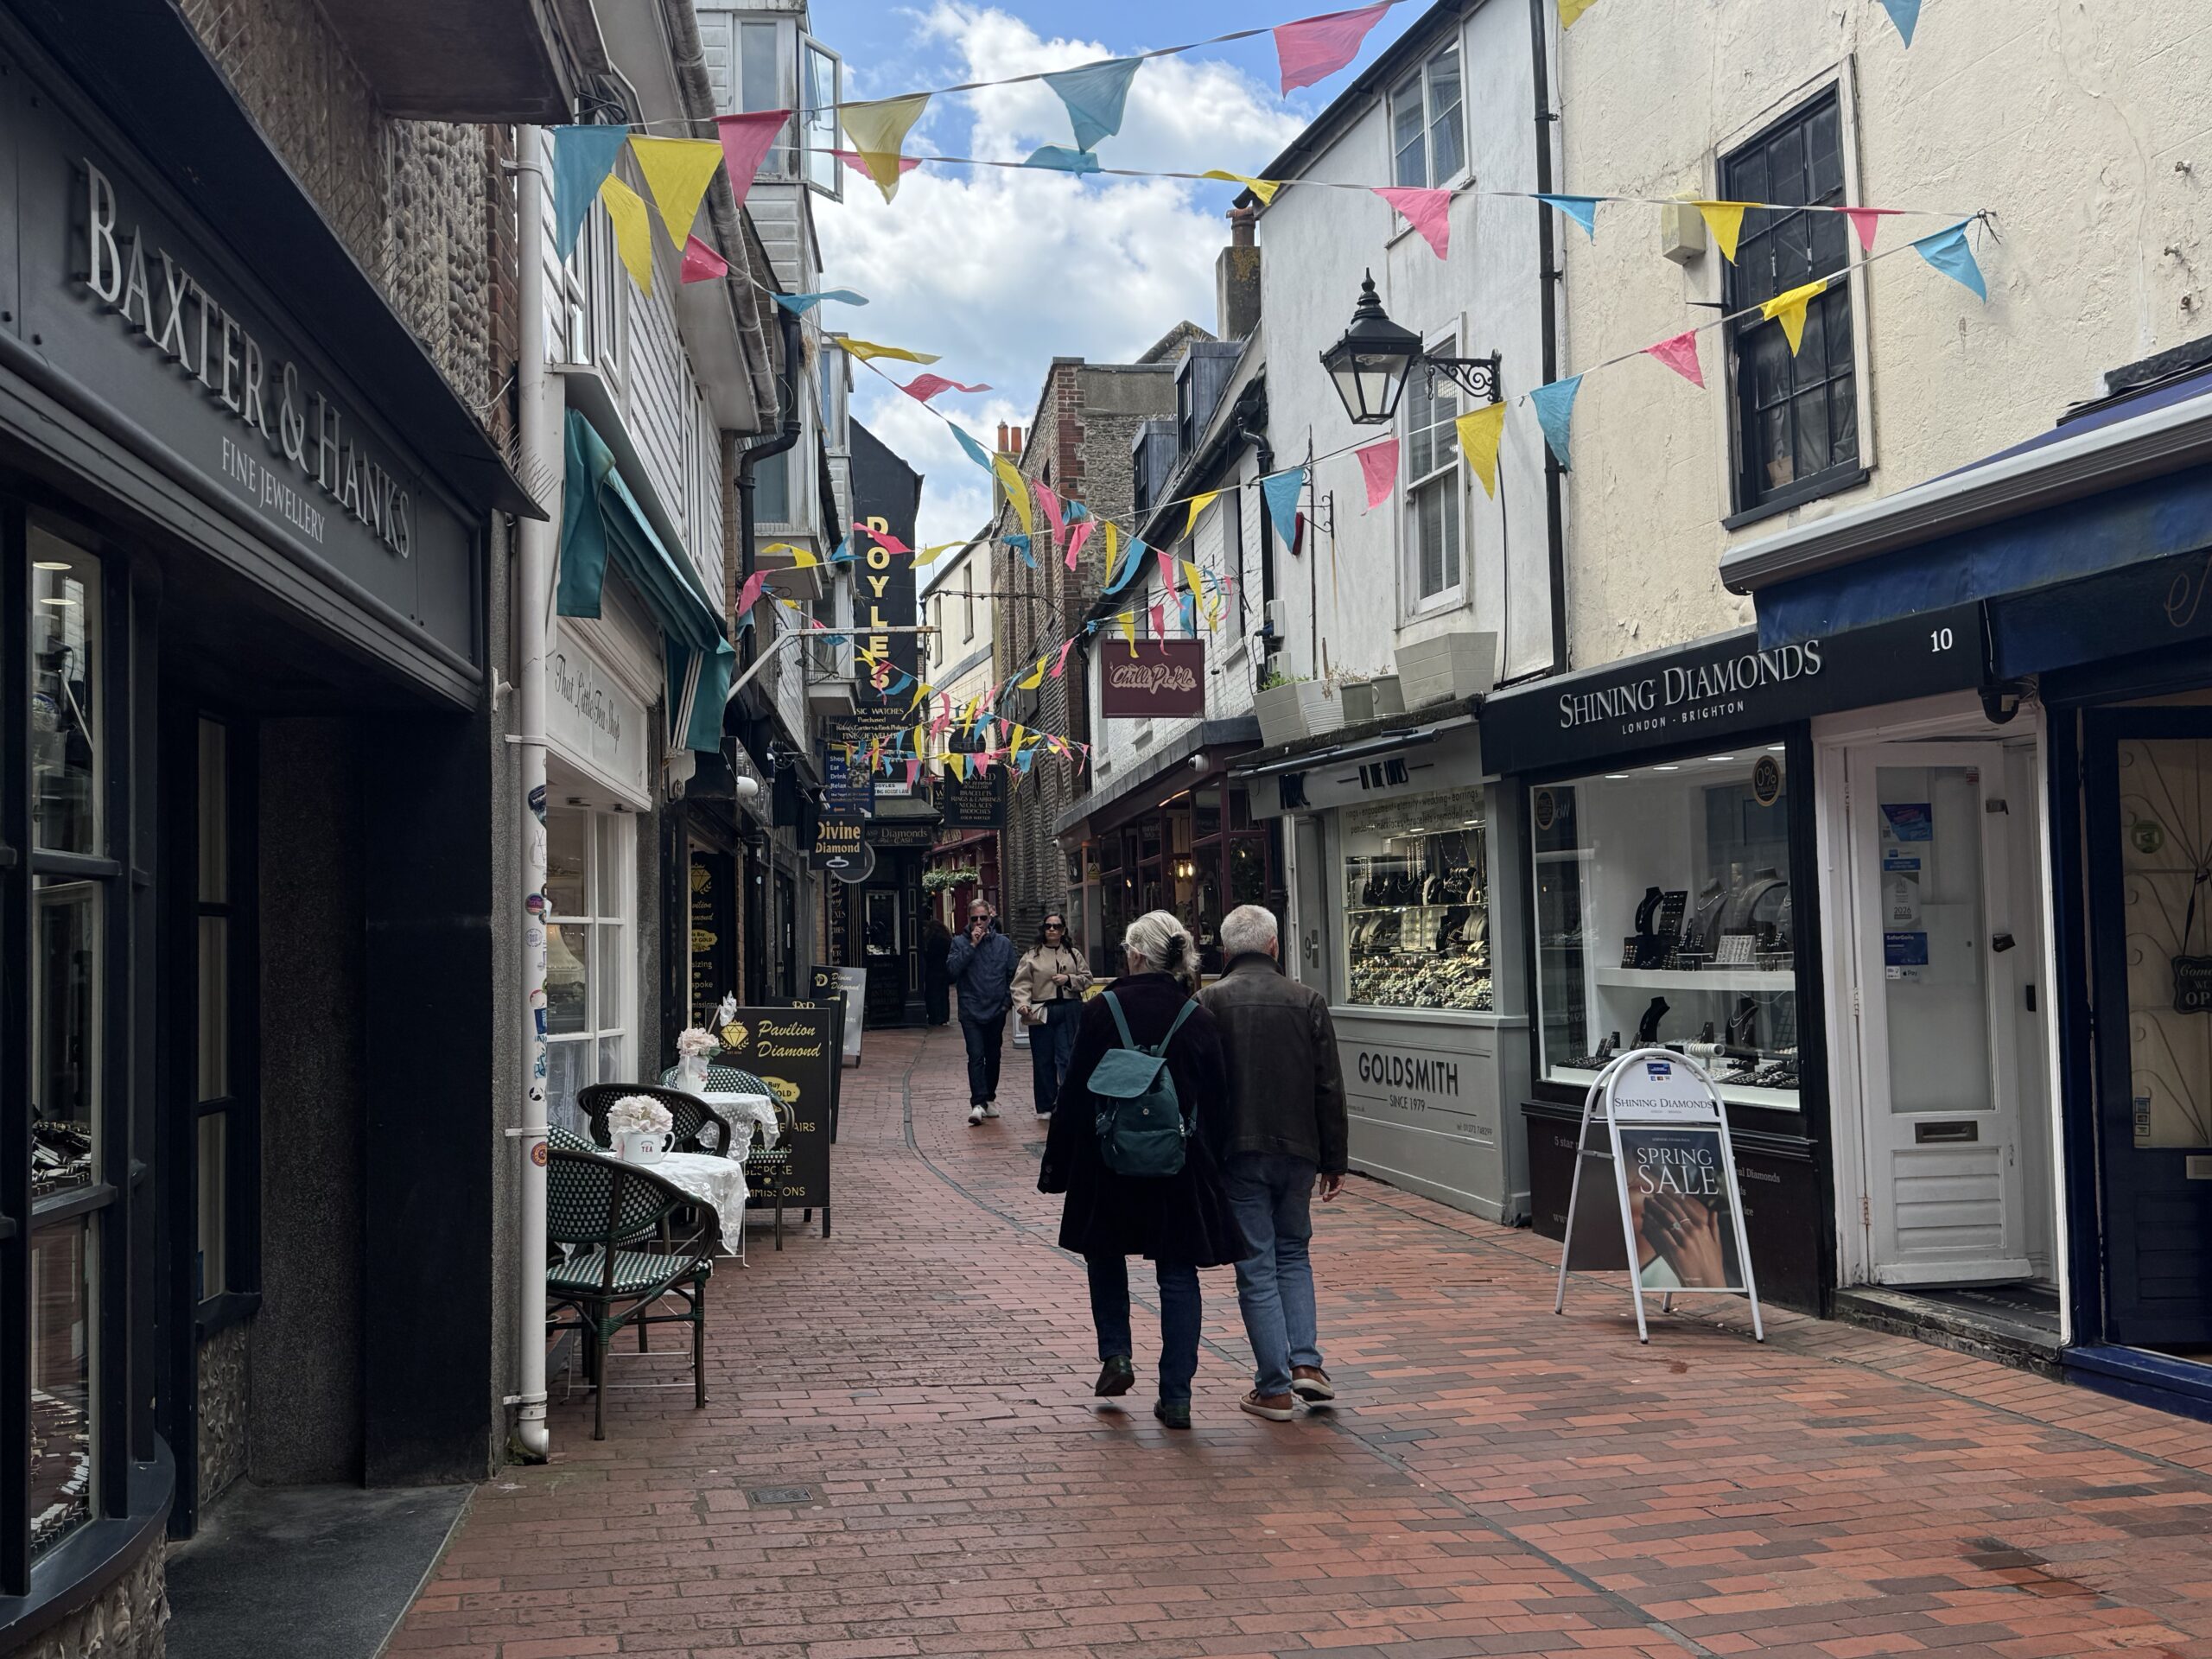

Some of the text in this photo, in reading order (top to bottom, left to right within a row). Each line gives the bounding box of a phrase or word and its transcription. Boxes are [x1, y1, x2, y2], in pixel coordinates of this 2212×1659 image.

[84, 157, 410, 559] BAXTER & HANKS
[221, 436, 324, 543] FINE JEWELLERY
[867, 517, 891, 689] DOYLES
[1930, 628, 1954, 652] 10
[555, 653, 574, 703] That
[575, 671, 594, 719] Little
[594, 690, 605, 729] Tea
[1559, 639, 1823, 728] SHINING DIAMONDS
[1622, 716, 1666, 734] LONDON
[1681, 701, 1745, 724] BRIGHTON
[881, 828, 927, 838] Diamonds
[815, 842, 861, 853] Diamond
[1305, 936, 1312, 960] 9
[2185, 991, 2210, 1005] OP
[758, 1020, 816, 1037] Pavilion
[757, 1040, 822, 1057] Diamond
[1358, 1052, 1459, 1096] GOLDSMITH
[1389, 1095, 1425, 1111] SINCE 1979
[1614, 1097, 1713, 1109] SHINING DIAMONDS
[1637, 1147, 1713, 1165] SPRING
[1637, 1165, 1719, 1195] SALE
[1746, 1168, 1780, 1183] Diamonds
